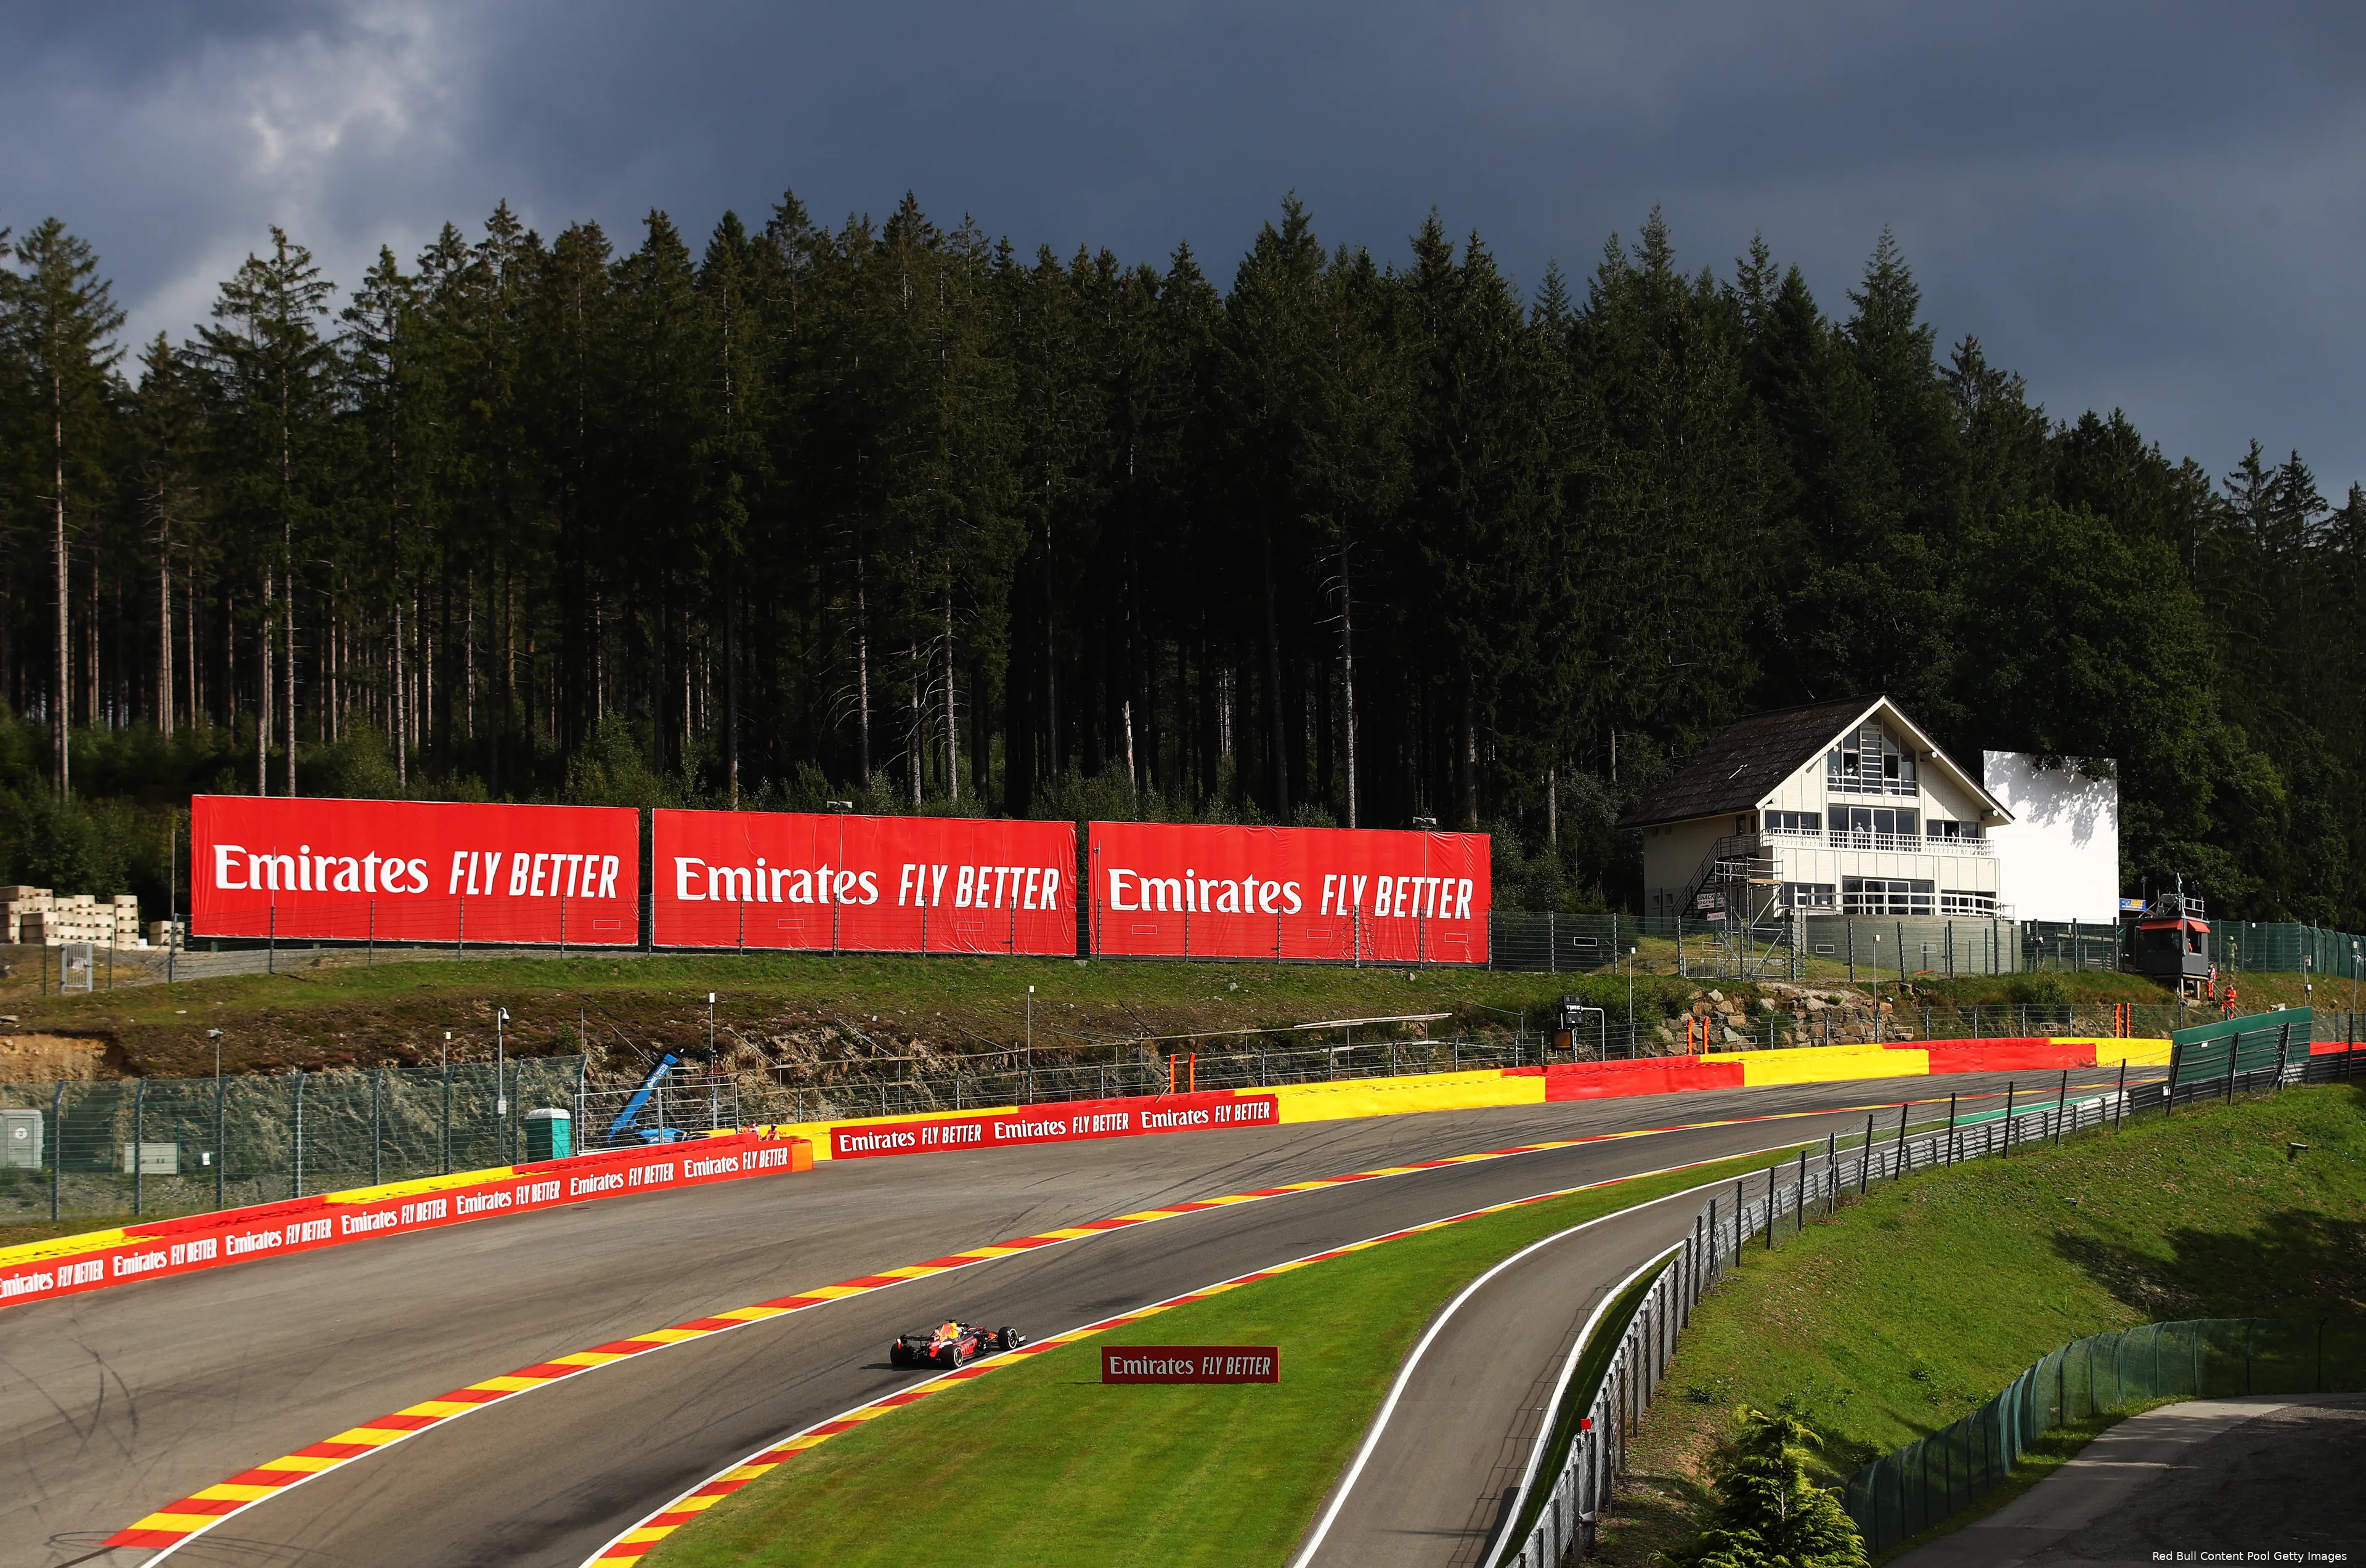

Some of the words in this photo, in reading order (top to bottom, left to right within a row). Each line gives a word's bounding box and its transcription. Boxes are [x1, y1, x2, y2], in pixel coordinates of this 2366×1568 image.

[213, 845, 429, 893] Emirates
[449, 851, 502, 895] FLY
[509, 853, 619, 898] BETTER
[674, 857, 879, 904] Emirates
[898, 864, 948, 907] FLY
[955, 866, 1059, 910] BETTER
[1108, 868, 1302, 914] Emirates
[1321, 874, 1367, 916] FLY
[1375, 875, 1473, 919] BETTER
[994, 1119, 1067, 1139] Emirates
[1073, 1116, 1089, 1134] FLY
[1093, 1113, 1129, 1132] BETTER
[1141, 1109, 1209, 1129] Emirates
[1215, 1105, 1232, 1123] FLY
[1235, 1102, 1270, 1121] BETTER
[839, 1131, 916, 1152] Emirates
[922, 1127, 938, 1145] FLY
[942, 1124, 982, 1144] BETTER
[684, 1156, 739, 1177] Emirates
[743, 1151, 758, 1170] FLY
[759, 1147, 788, 1168] BETTER
[571, 1173, 624, 1195] Emirates
[629, 1167, 644, 1186] FLY
[644, 1163, 674, 1184] BETTER
[456, 1191, 512, 1214] Emirates
[516, 1185, 530, 1204] FLY
[532, 1180, 561, 1202] BETTER
[341, 1211, 397, 1235] Emirates
[401, 1204, 415, 1225] FLY
[417, 1198, 447, 1222] BETTER
[226, 1230, 282, 1256] Emirates
[286, 1224, 301, 1245] FLY
[301, 1219, 332, 1242] BETTER
[57, 1265, 73, 1288] FLY
[73, 1259, 104, 1285] BETTER
[113, 1251, 167, 1277] Emirates
[171, 1243, 185, 1266] FLY
[187, 1238, 217, 1262] BETTER
[1110, 1355, 1193, 1375] Emirates
[1202, 1357, 1223, 1375] FLY
[1226, 1357, 1270, 1375] BETTER
